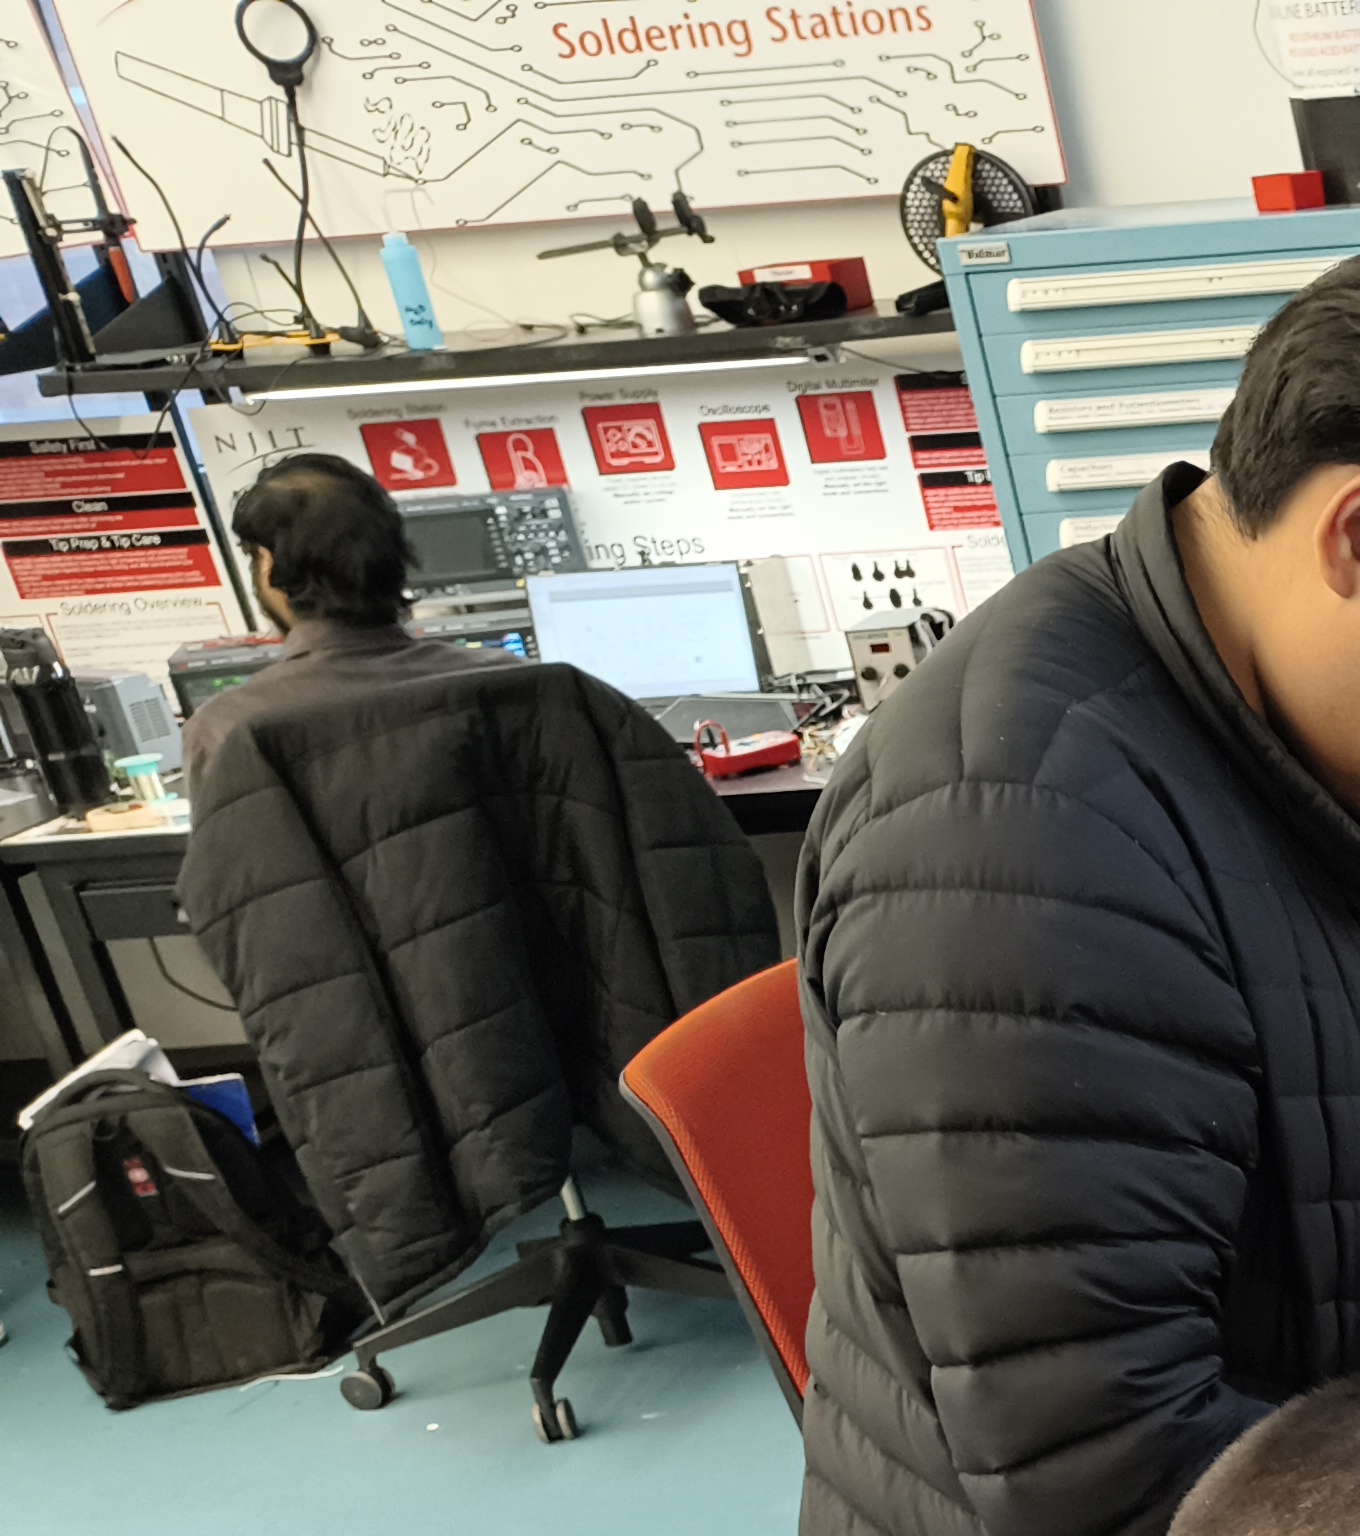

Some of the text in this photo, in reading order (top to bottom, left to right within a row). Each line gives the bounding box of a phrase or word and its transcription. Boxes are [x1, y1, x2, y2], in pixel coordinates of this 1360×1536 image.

[552, 1, 934, 62] Soldering Stations
[215, 427, 304, 454] NJIT
[633, 532, 705, 558] Steps
[60, 596, 203, 615] Soldering Overview
